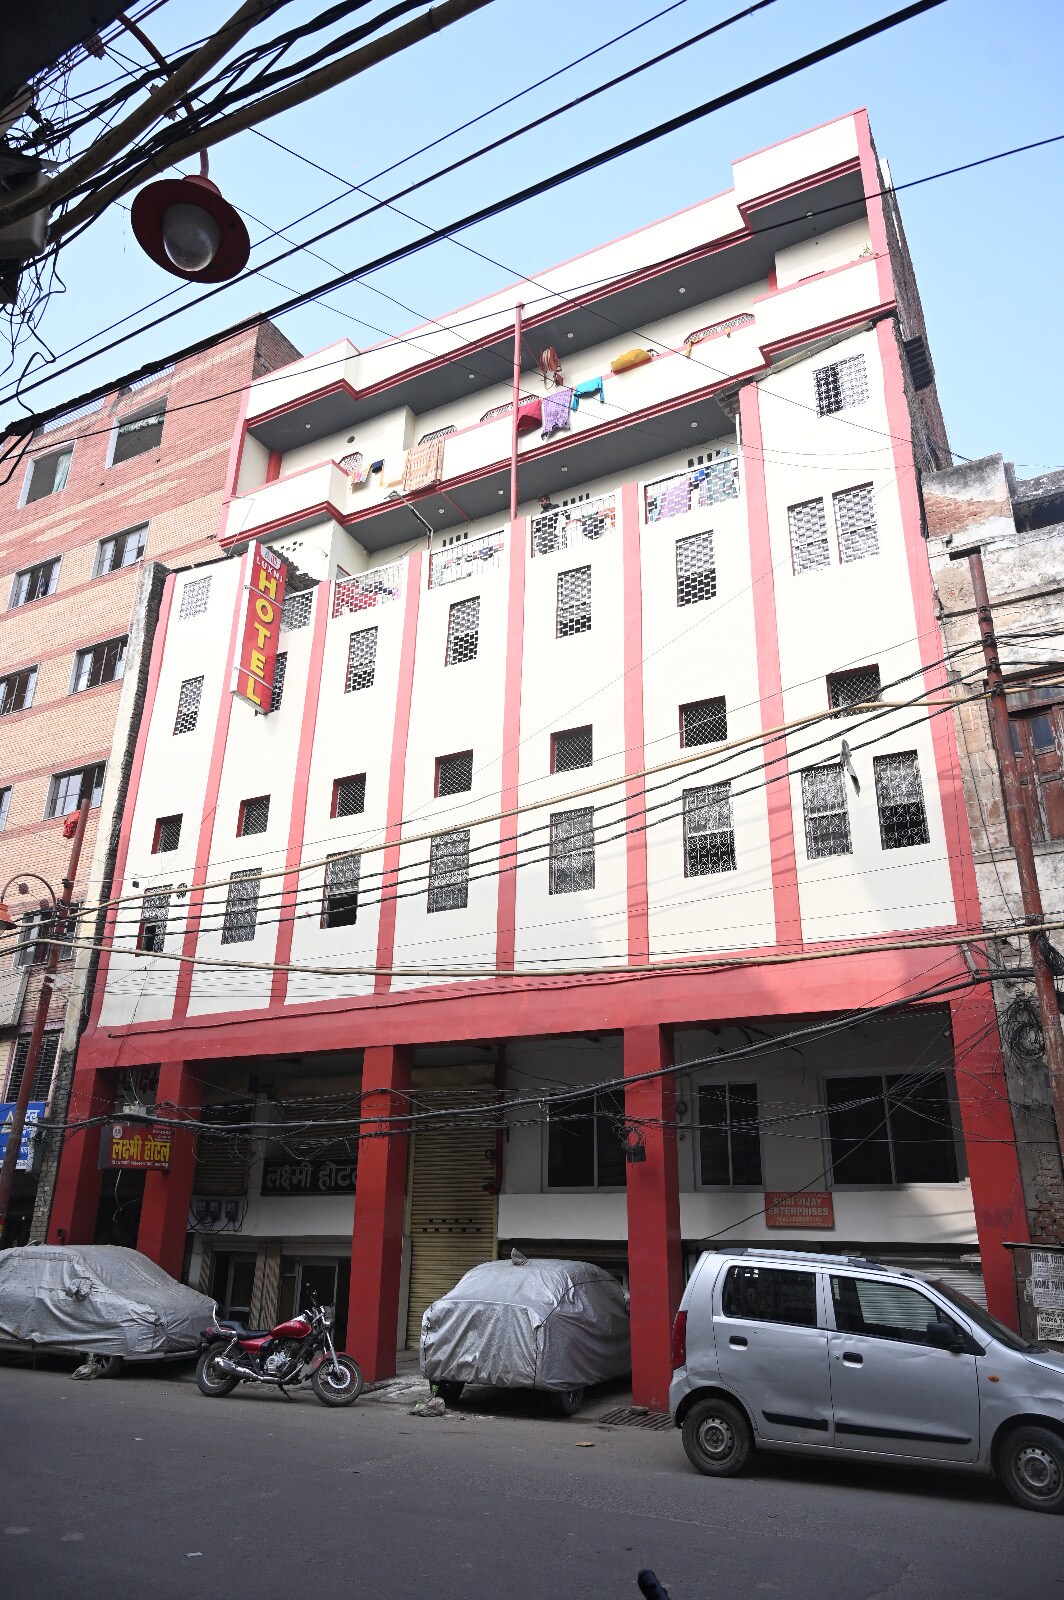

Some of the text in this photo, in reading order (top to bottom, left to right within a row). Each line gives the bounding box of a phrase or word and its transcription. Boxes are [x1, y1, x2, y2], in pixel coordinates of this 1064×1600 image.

[256, 555, 283, 583] LUXMI
[246, 569, 277, 706] HOTEL
[111, 1134, 171, 1162] लक्ष्मी होटल
[266, 1161, 314, 1190] लक्ष्मी
[768, 1207, 828, 1216] ENTERPRISES
[797, 1198, 822, 1206] VIJAY
[1033, 1253, 1050, 1264] HOME
[1034, 1280, 1050, 1290] HOME
